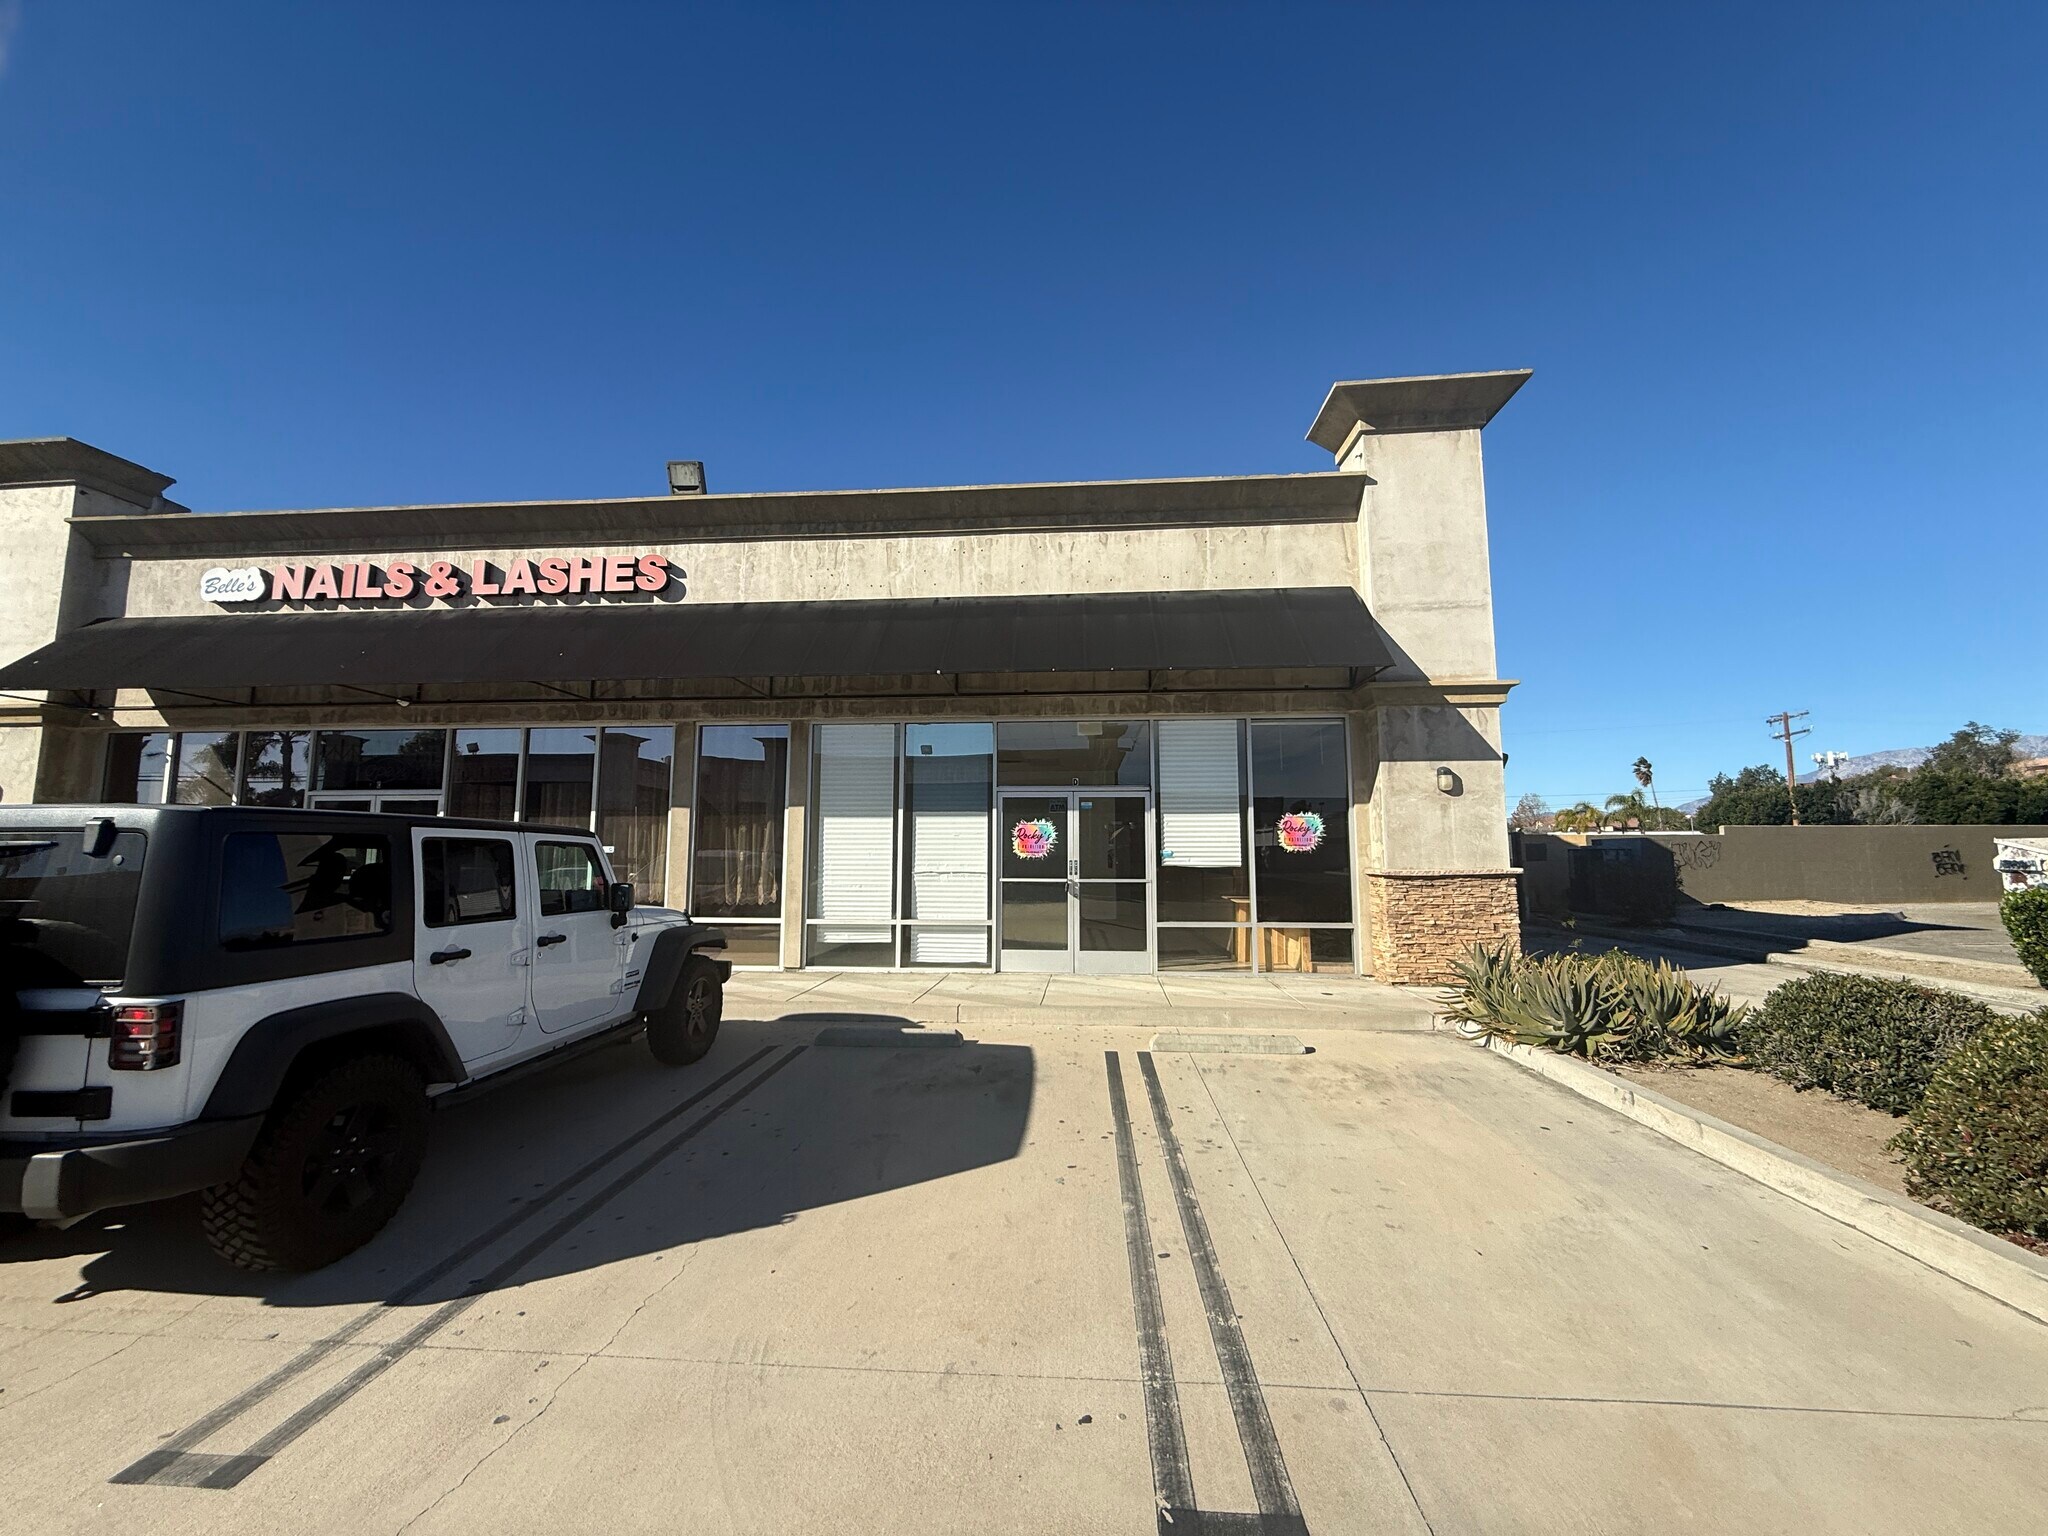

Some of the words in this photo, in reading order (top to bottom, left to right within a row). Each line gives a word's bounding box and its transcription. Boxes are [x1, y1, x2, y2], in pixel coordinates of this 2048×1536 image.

[204, 574, 257, 594] Belle's
[271, 562, 415, 600] NAILS
[424, 561, 462, 597] &
[472, 554, 668, 595] LASHES
[1015, 827, 1051, 844] Rocky's
[1281, 820, 1318, 837] Rocky's
